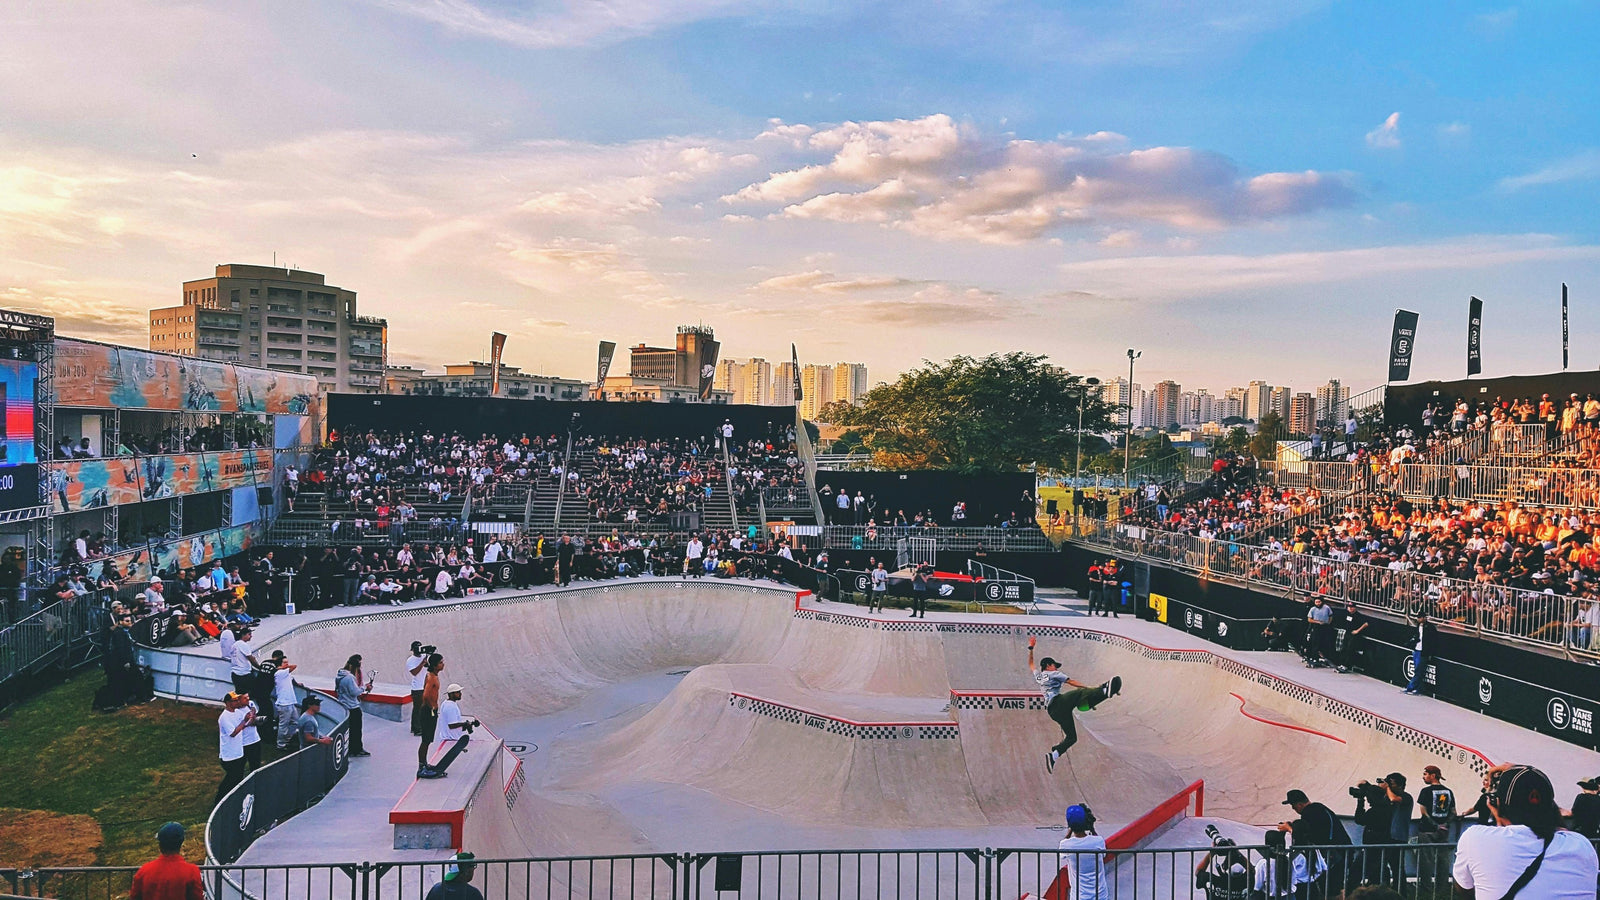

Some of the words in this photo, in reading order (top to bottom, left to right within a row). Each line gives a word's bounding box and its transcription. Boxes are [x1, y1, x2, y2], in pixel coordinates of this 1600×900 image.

[814, 613, 832, 623] VANS
[935, 624, 957, 633] VANS
[1082, 631, 1103, 642] VANS
[1169, 651, 1182, 661] VANS
[1257, 673, 1272, 688] VANS
[997, 697, 1025, 710] VANS
[1572, 707, 1592, 721] VANS
[804, 714, 827, 730] VANS
[1375, 718, 1395, 736] VANS
[1572, 717, 1592, 729] PARK
